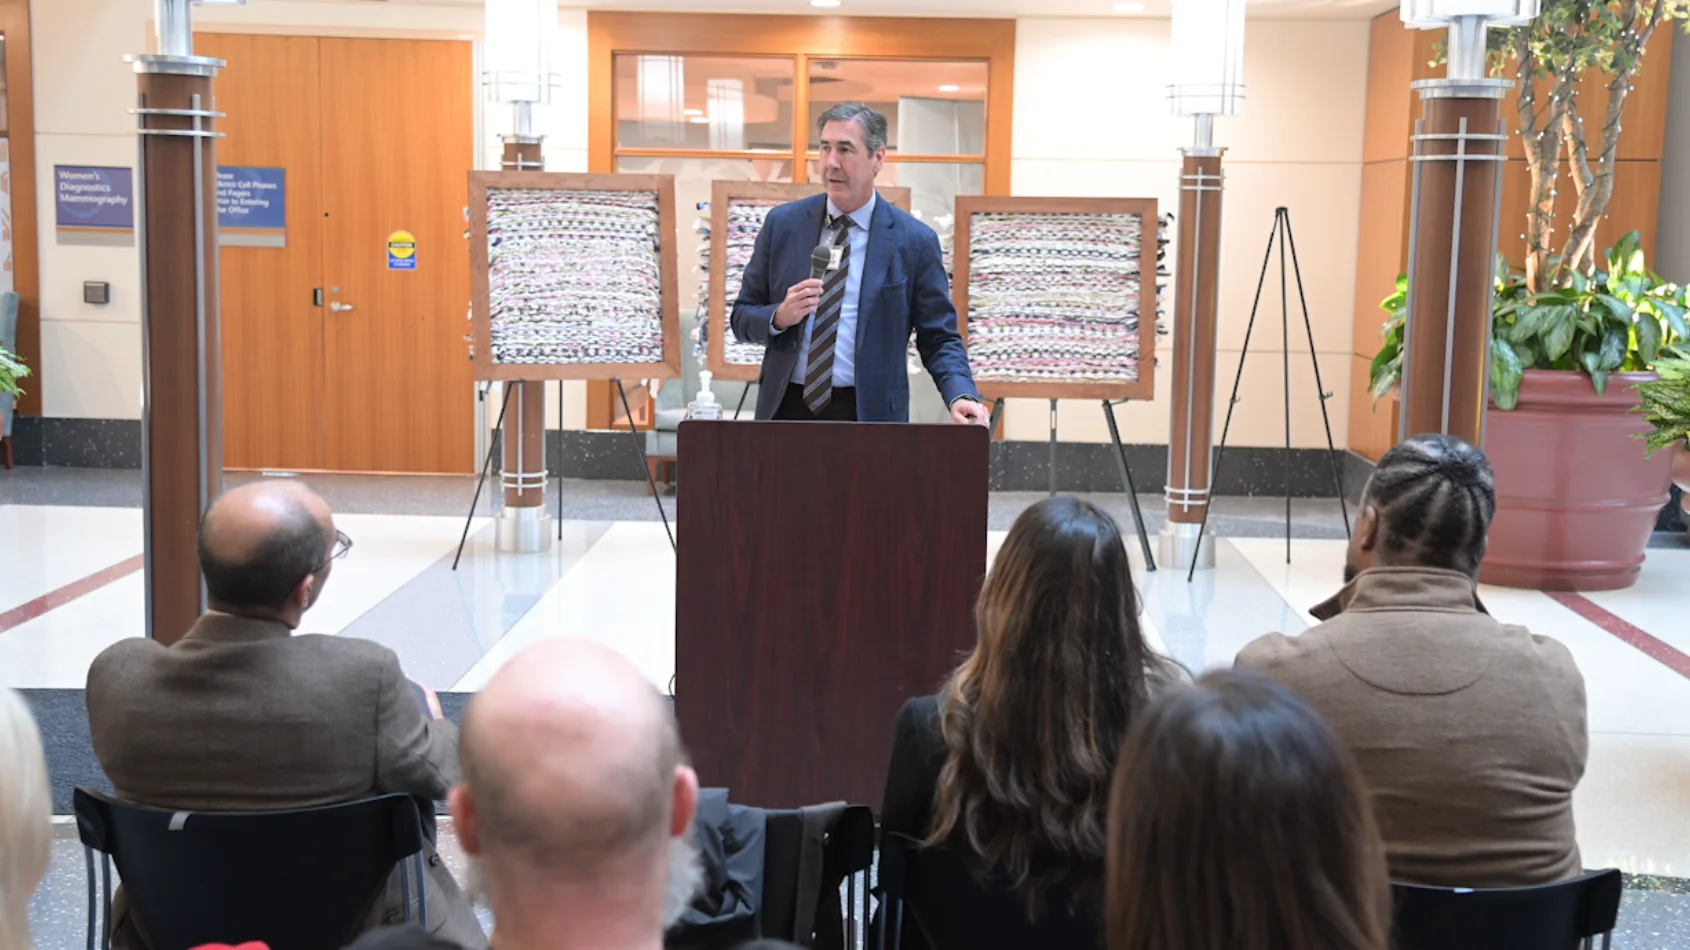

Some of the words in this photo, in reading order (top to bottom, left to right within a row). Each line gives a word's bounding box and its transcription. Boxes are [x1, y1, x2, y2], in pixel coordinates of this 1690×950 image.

[59, 171, 100, 180] Women's
[217, 172, 234, 180] lease
[60, 182, 111, 193] Diagnostics
[238, 181, 251, 189] Cell
[217, 189, 227, 197] nd
[228, 189, 251, 198] Pagers
[60, 194, 128, 206] Mammography
[240, 198, 269, 208] Entering
[228, 206, 249, 214] Office
